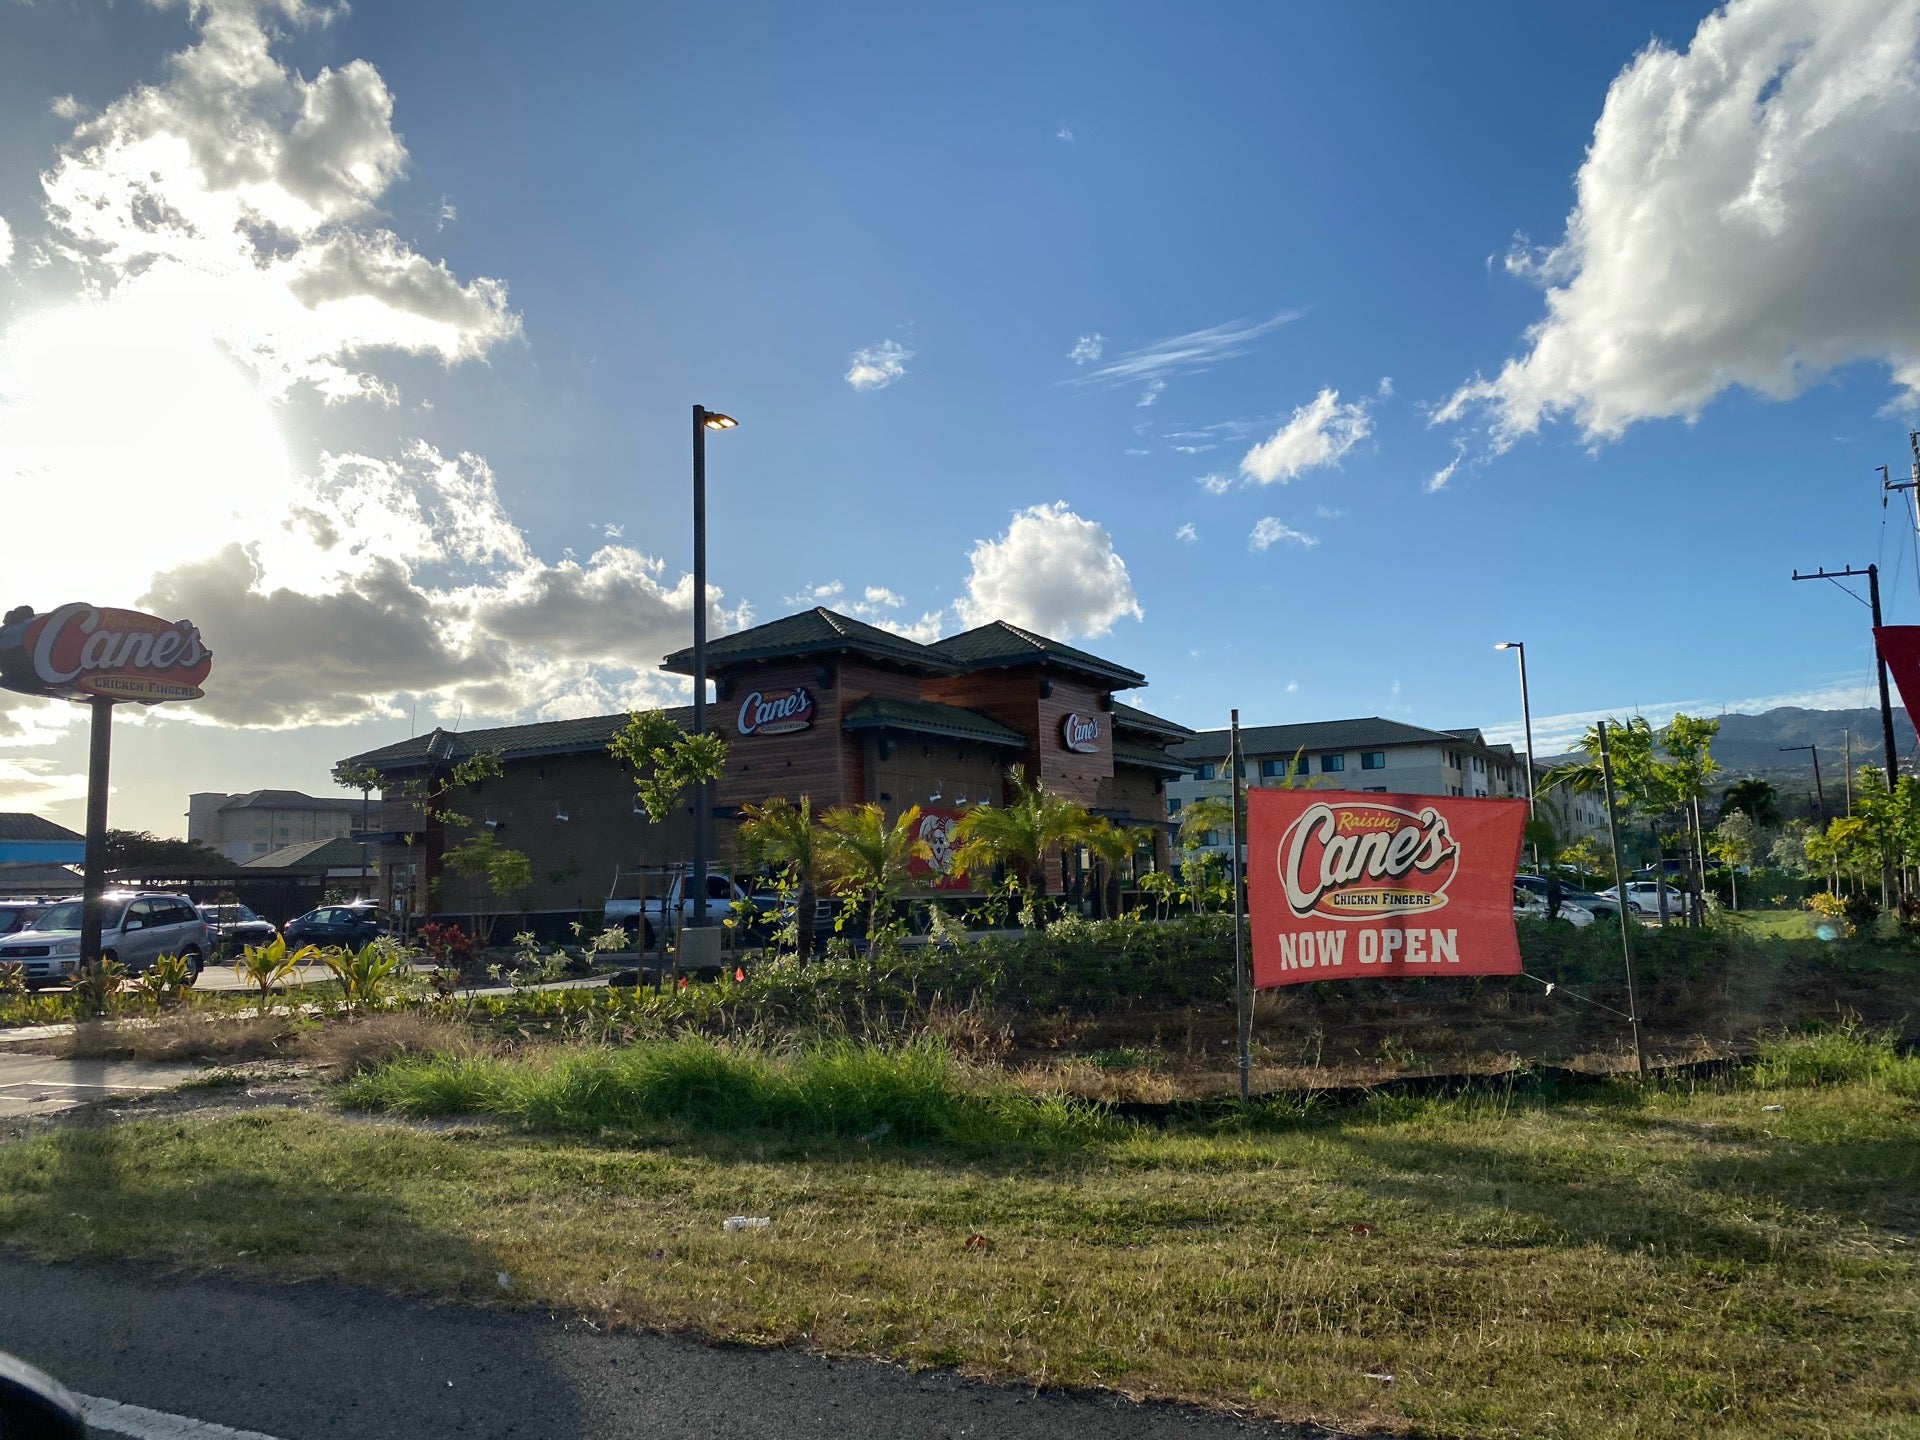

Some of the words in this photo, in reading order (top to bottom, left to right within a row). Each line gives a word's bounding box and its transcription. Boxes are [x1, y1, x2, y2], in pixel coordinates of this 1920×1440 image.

[34, 602, 212, 683] Cane's
[737, 687, 812, 735] Cane's
[1338, 811, 1401, 833] Raising
[1286, 804, 1457, 909] Cane's
[1333, 893, 1378, 906] CHICKEN
[1382, 893, 1431, 905] FINGERS
[1278, 929, 1347, 971] NOW
[1358, 928, 1460, 965] OPEN
